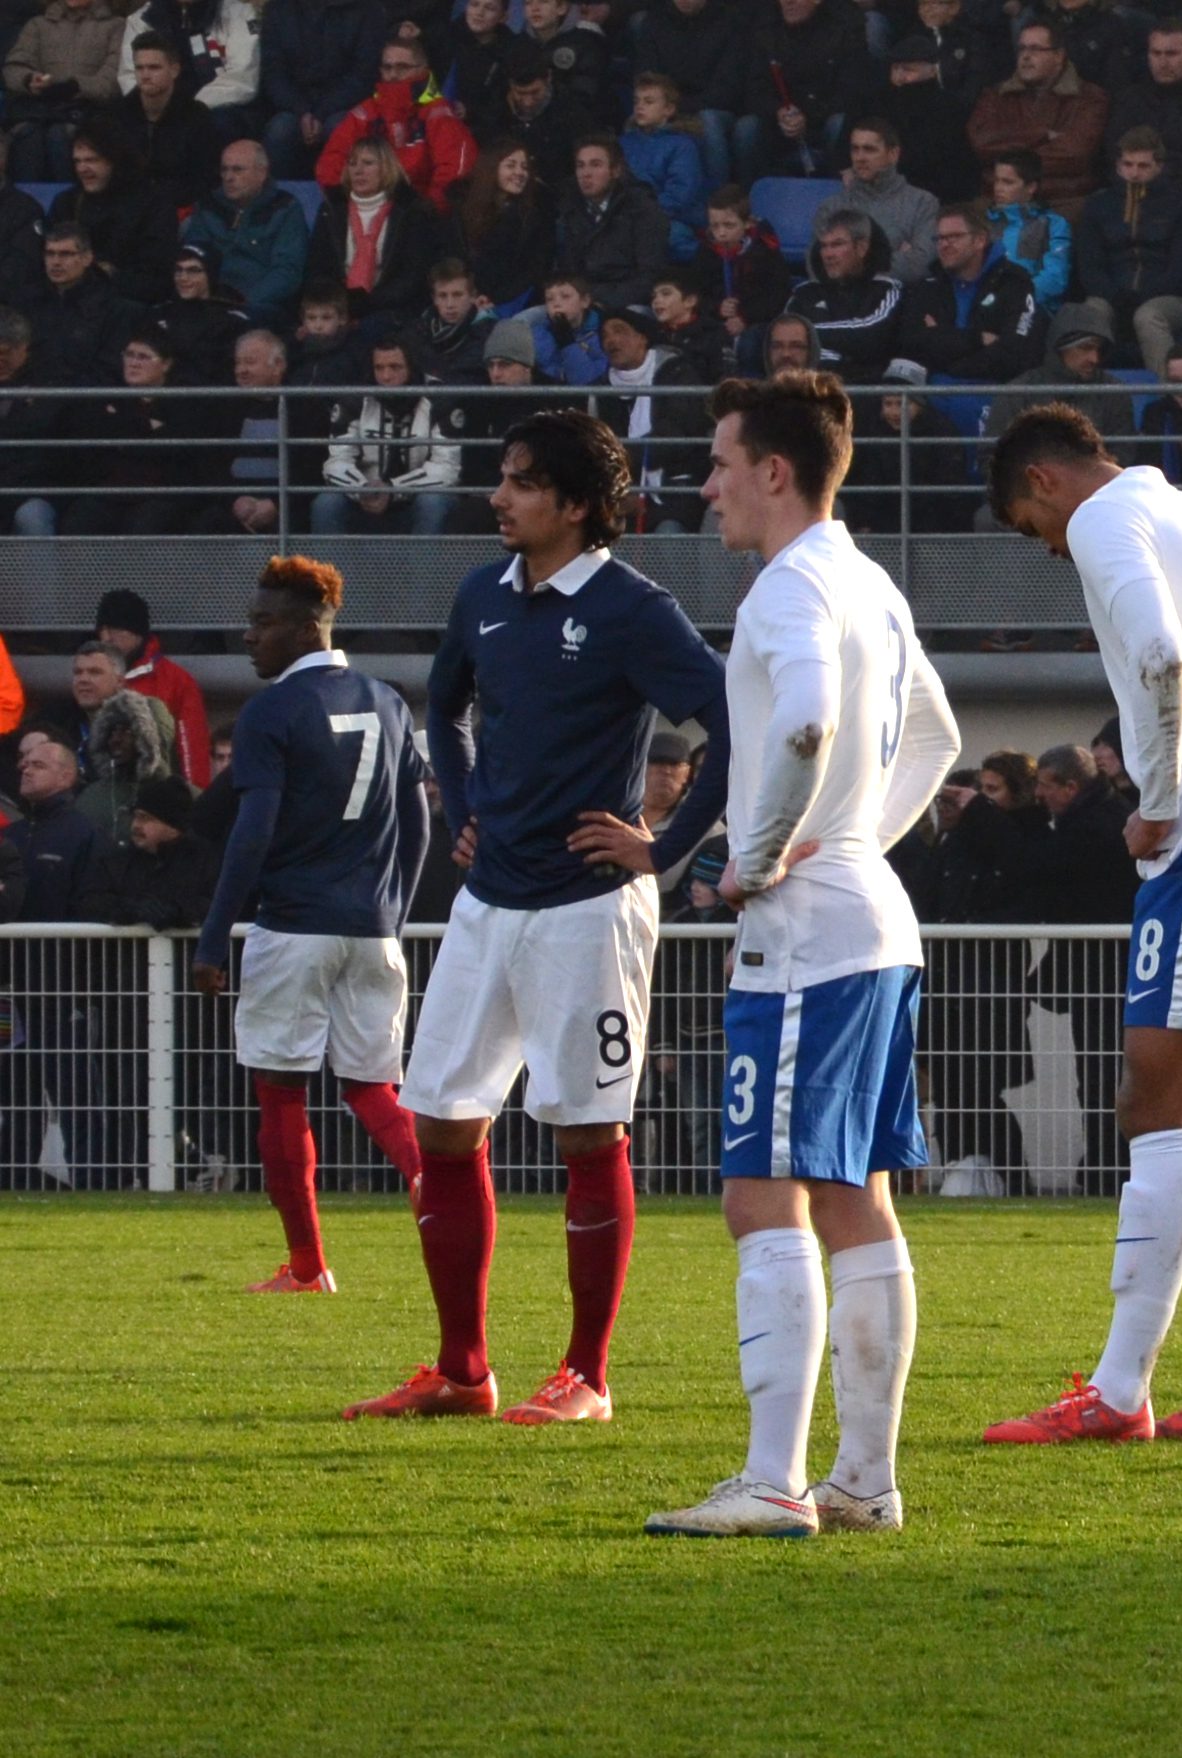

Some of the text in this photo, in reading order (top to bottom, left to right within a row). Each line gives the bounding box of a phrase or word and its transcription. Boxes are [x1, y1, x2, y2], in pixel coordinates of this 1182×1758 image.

[881, 609, 907, 769] 3
[329, 712, 381, 820] 7
[1135, 918, 1164, 981] 8
[596, 1009, 631, 1067] 8
[728, 1054, 757, 1125] 3
